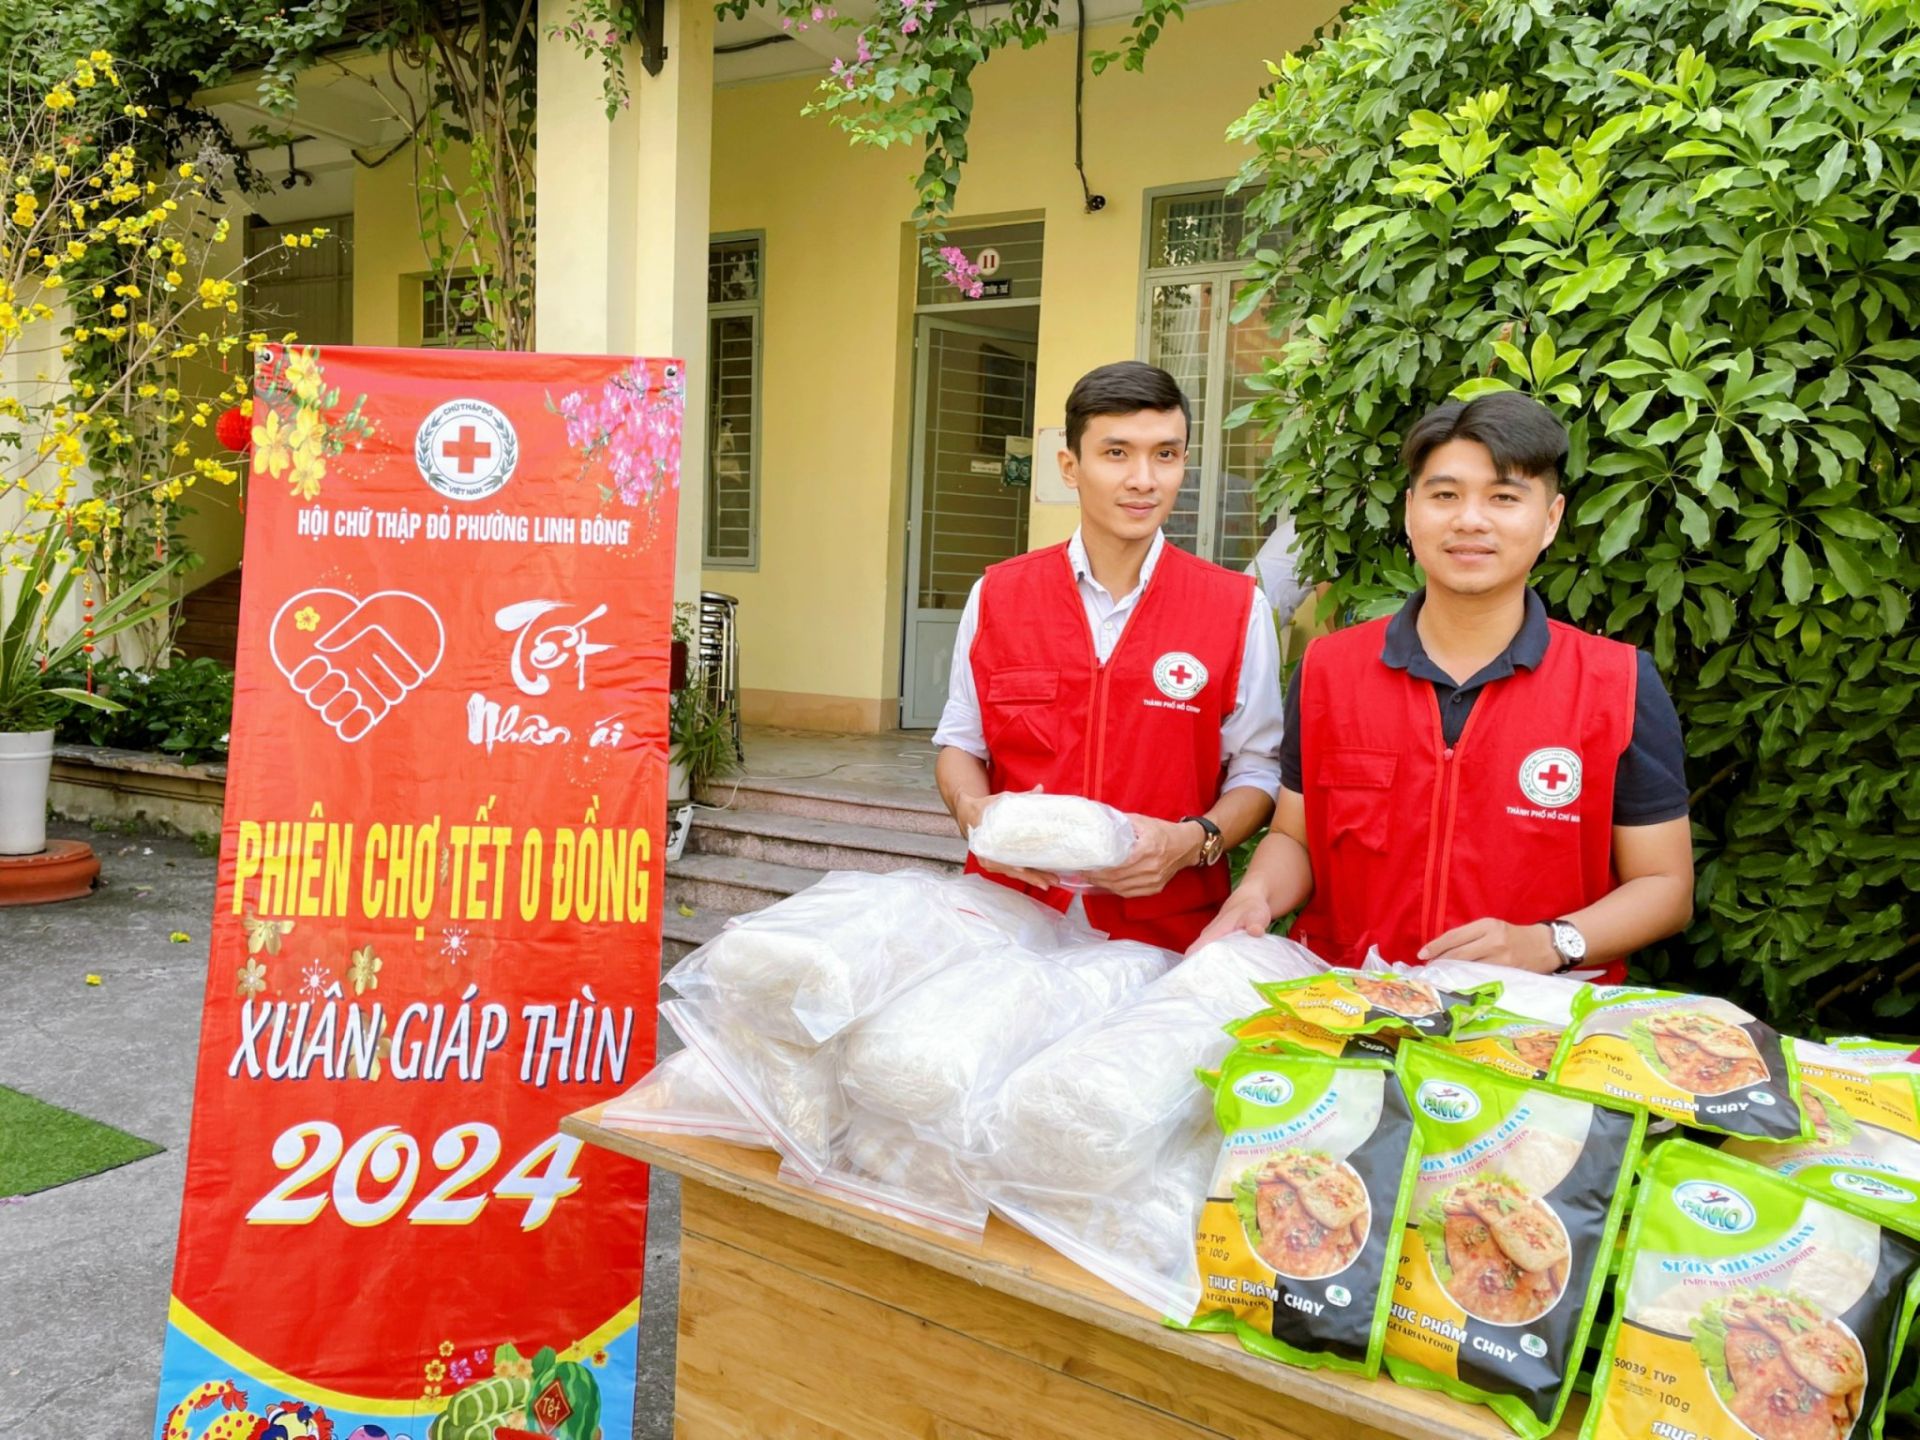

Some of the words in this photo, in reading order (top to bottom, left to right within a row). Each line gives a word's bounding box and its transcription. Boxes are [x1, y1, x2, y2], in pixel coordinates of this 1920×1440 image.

[297, 504, 329, 541] HỘI
[334, 506, 374, 537] CHỮ
[376, 507, 422, 544] THẬP
[426, 505, 451, 540] ĐỎ
[455, 509, 529, 542] PHƯỜNG
[534, 517, 575, 544] LINH
[580, 513, 630, 545] ĐÔNG
[467, 692, 571, 757] Nhân
[589, 712, 625, 747] ái
[232, 801, 353, 916] PHIÊN
[362, 815, 441, 941] CHỢ
[449, 795, 513, 921] TẾT
[550, 795, 651, 924] ĐỒNG
[228, 981, 384, 1082] XUÂN
[389, 983, 510, 1083] GIÁP
[519, 984, 634, 1088] THÌN
[1705, 1101, 1750, 1115] CHAY
[245, 1120, 586, 1232] 2024
[1681, 1199, 1743, 1230] PANKO
[1284, 1293, 1325, 1318] CHAY
[1473, 1336, 1519, 1363] CHAY
